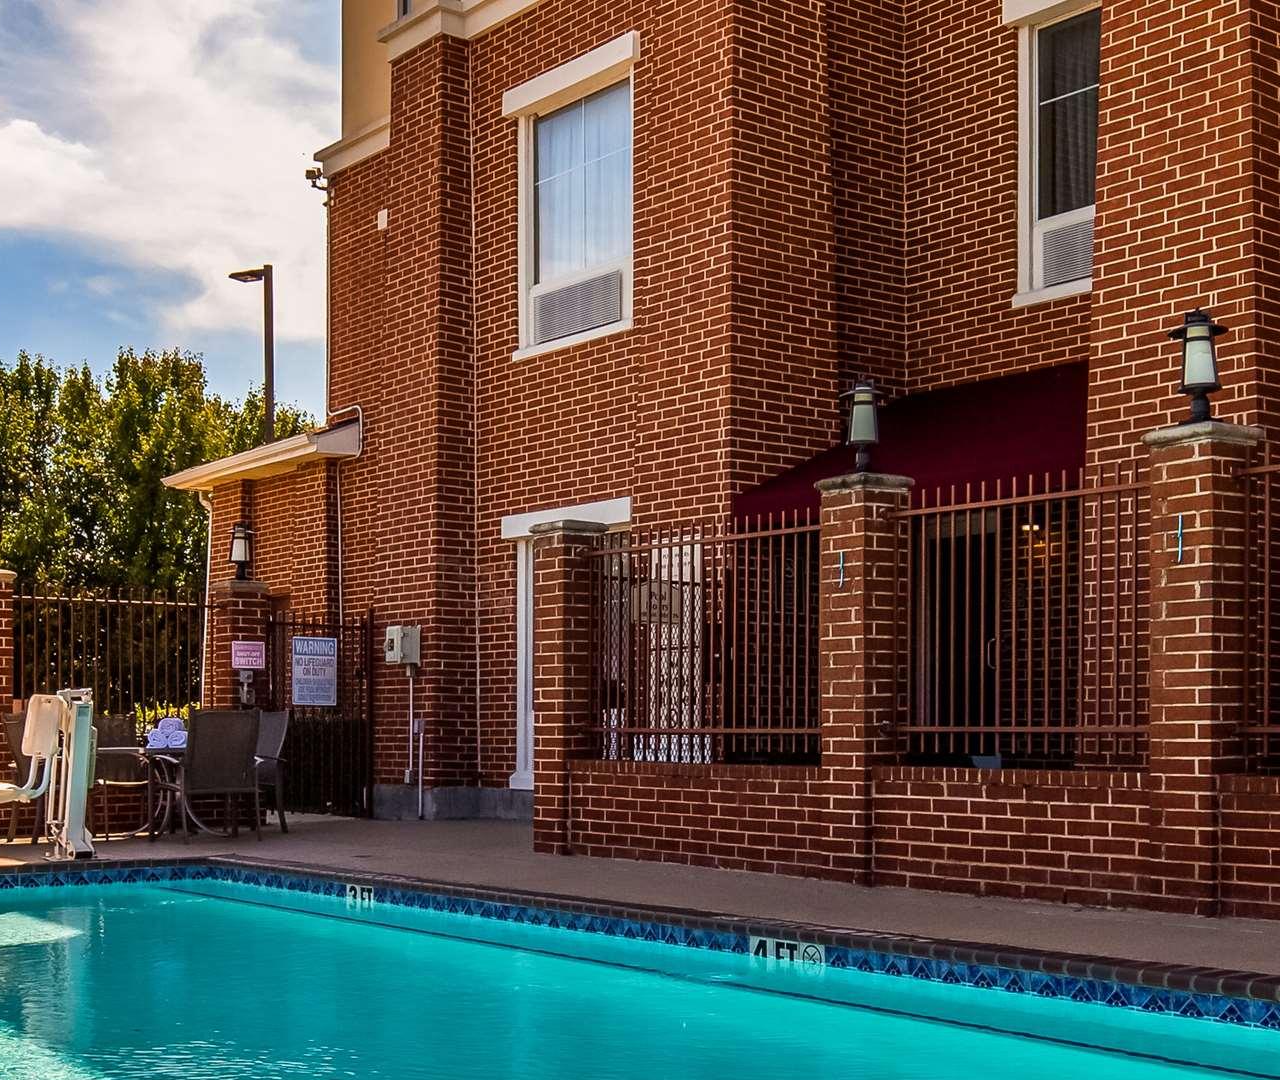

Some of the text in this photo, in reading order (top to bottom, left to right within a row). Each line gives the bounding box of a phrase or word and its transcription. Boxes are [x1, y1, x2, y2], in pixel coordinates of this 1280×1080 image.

[295, 640, 334, 655] WARNING
[235, 657, 262, 665] SWITCH
[295, 657, 335, 667] NO LIFEGUARD
